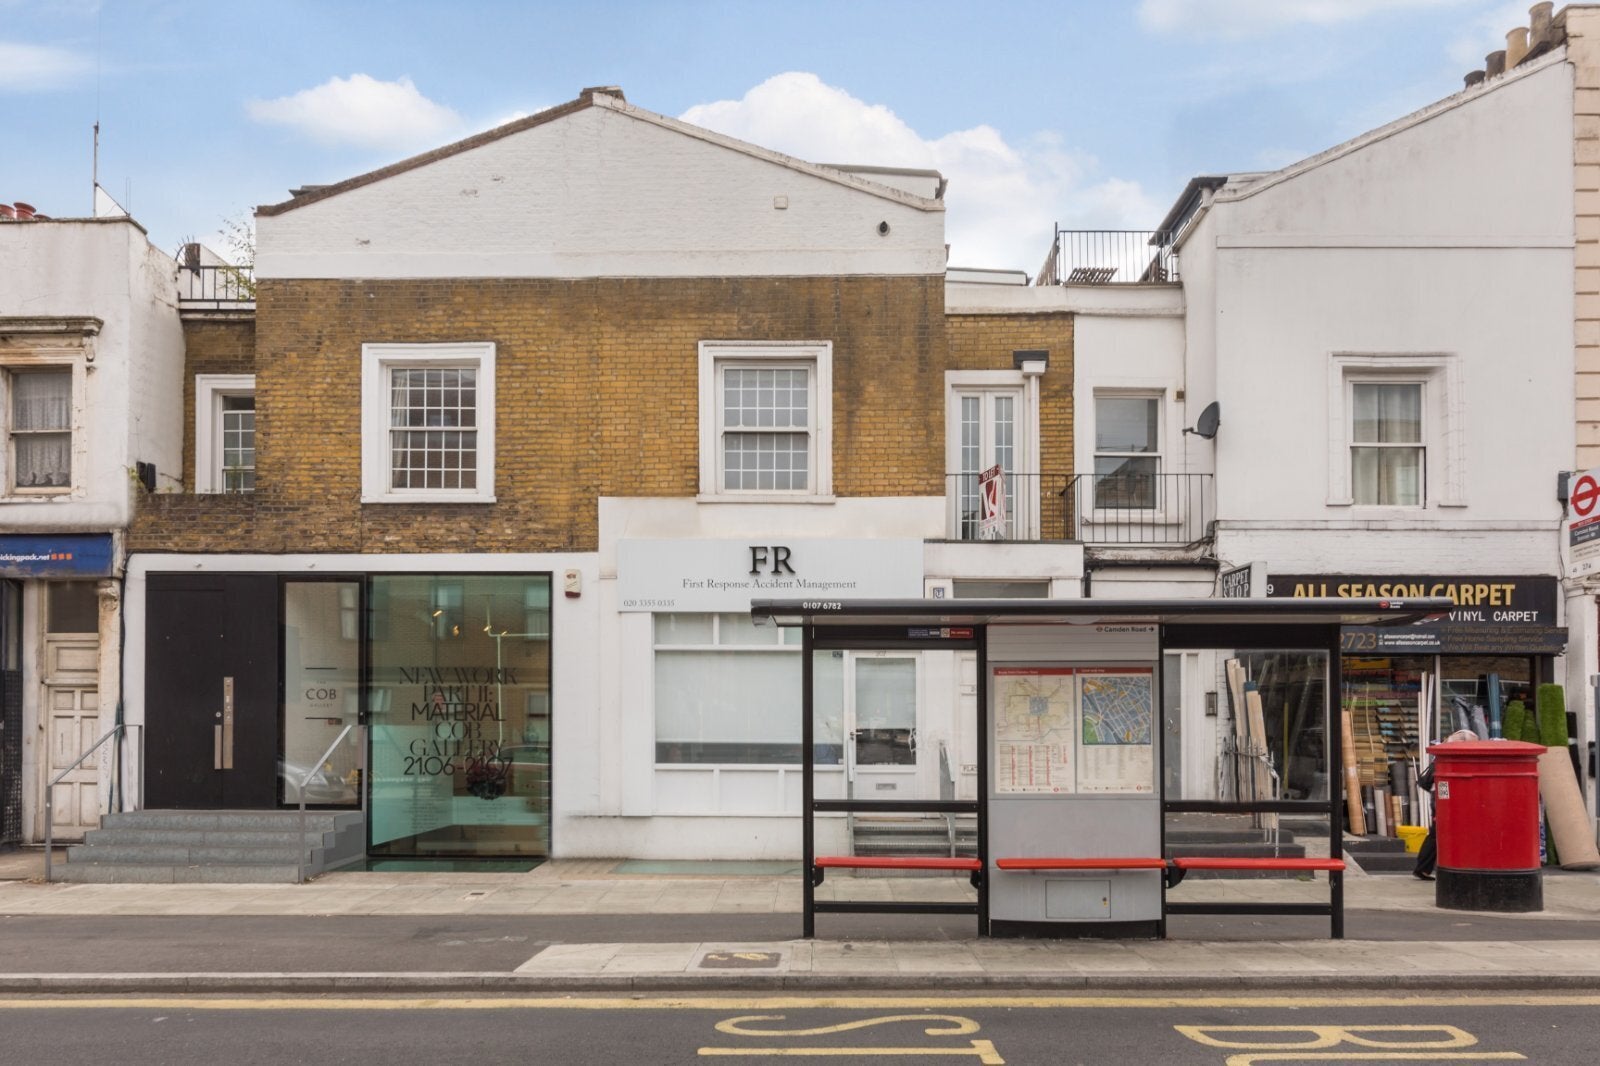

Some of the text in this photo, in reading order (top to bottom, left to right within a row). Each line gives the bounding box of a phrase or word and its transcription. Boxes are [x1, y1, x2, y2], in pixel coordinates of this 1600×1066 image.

[0, 553, 50, 562] ickingpack.net
[749, 545, 796, 575] FR
[682, 577, 857, 592] First Response Accident Management
[1222, 568, 1249, 589] CARPET
[1429, 583, 1516, 606] CARPET
[802, 602, 842, 610] 0107 6782
[1448, 611, 1539, 622] VINYL CARPET
[1104, 625, 1147, 634] Camden Road
[454, 666, 519, 685] WORK
[305, 688, 337, 700] COB
[411, 702, 507, 721] MATERIAL
[435, 721, 481, 739] COB
[410, 738, 507, 756] GALLERY
